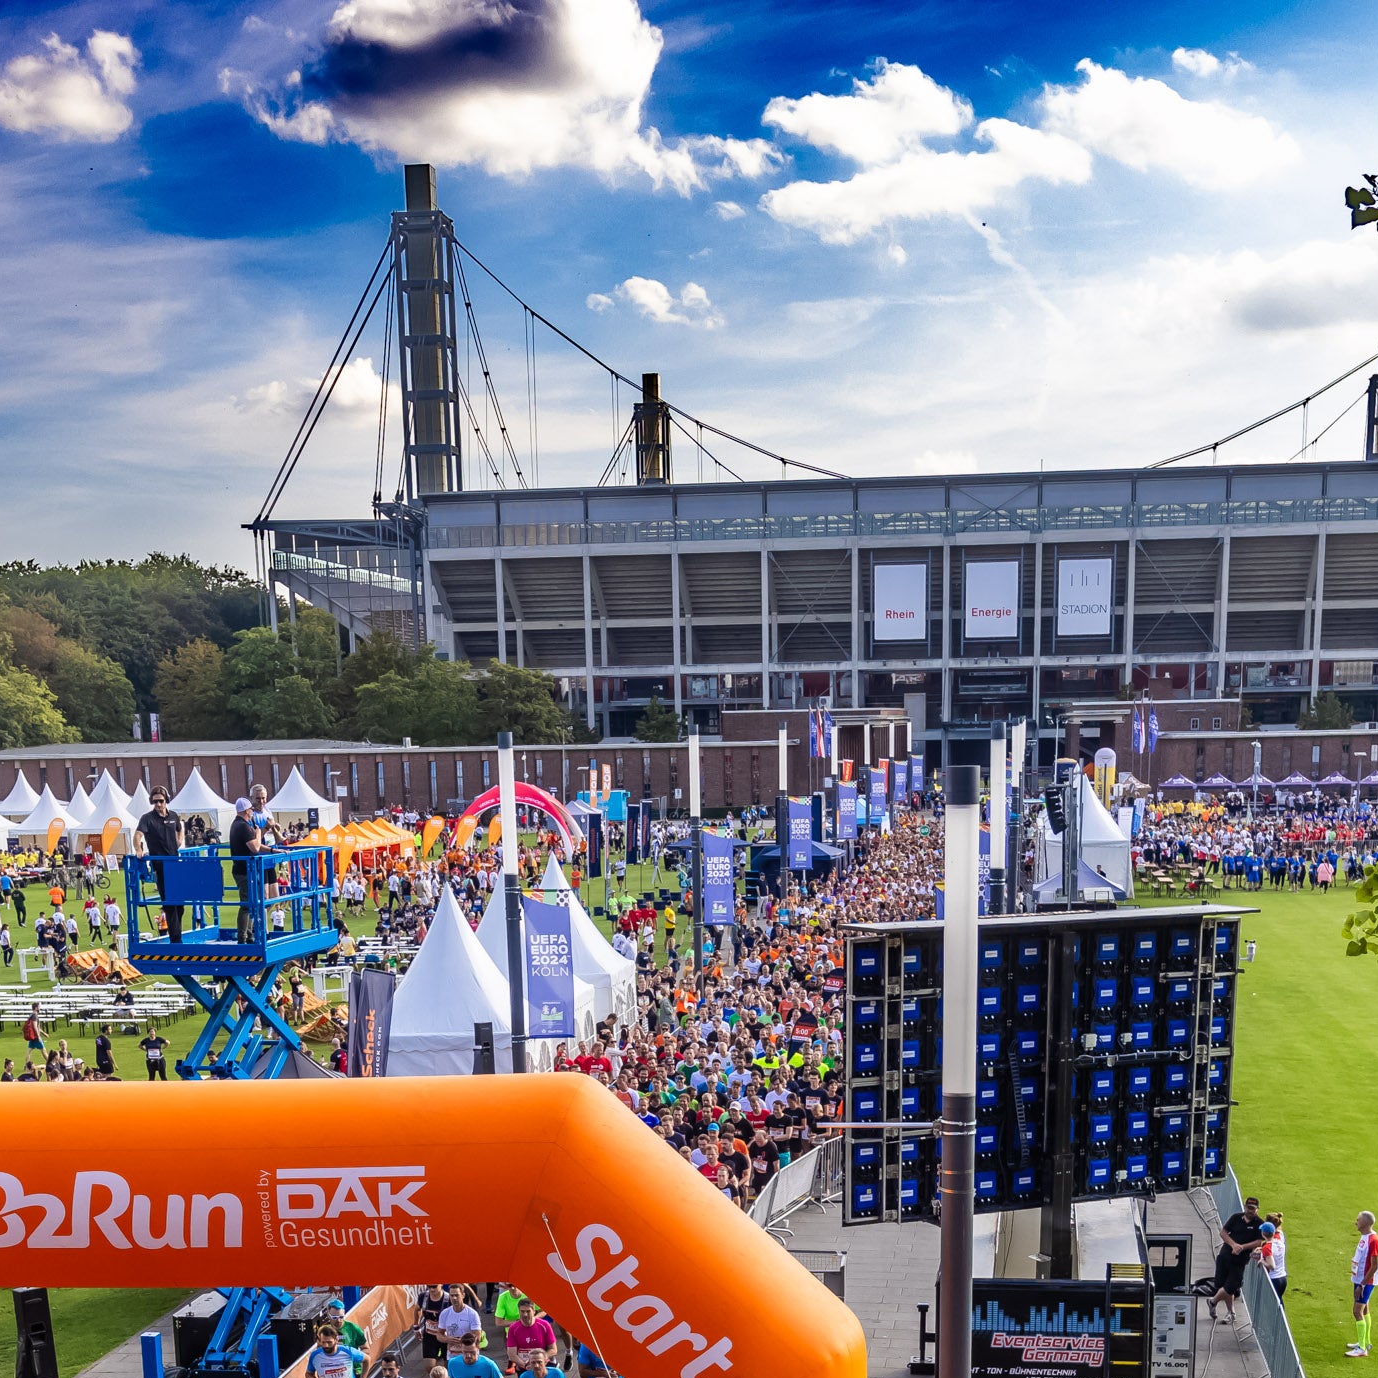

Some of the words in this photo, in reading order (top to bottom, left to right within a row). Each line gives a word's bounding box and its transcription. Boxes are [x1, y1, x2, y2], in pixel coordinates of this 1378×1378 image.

[885, 609, 915, 620] Rhein
[971, 606, 1012, 619] Energie
[1061, 603, 1108, 615] STADION
[707, 877, 731, 885] KÖLN
[530, 934, 568, 945] UEFA
[530, 945, 569, 955] EURO
[531, 955, 569, 965] 2024
[532, 964, 569, 977] KÖLN
[258, 1169, 272, 1187] by
[276, 1166, 429, 1219] DAK
[263, 1192, 276, 1248] powered
[279, 1219, 434, 1248] Gesundheit
[991, 1332, 1106, 1350] Eventservice
[1022, 1348, 1105, 1368] Germany
[986, 1367, 1003, 1375] TON
